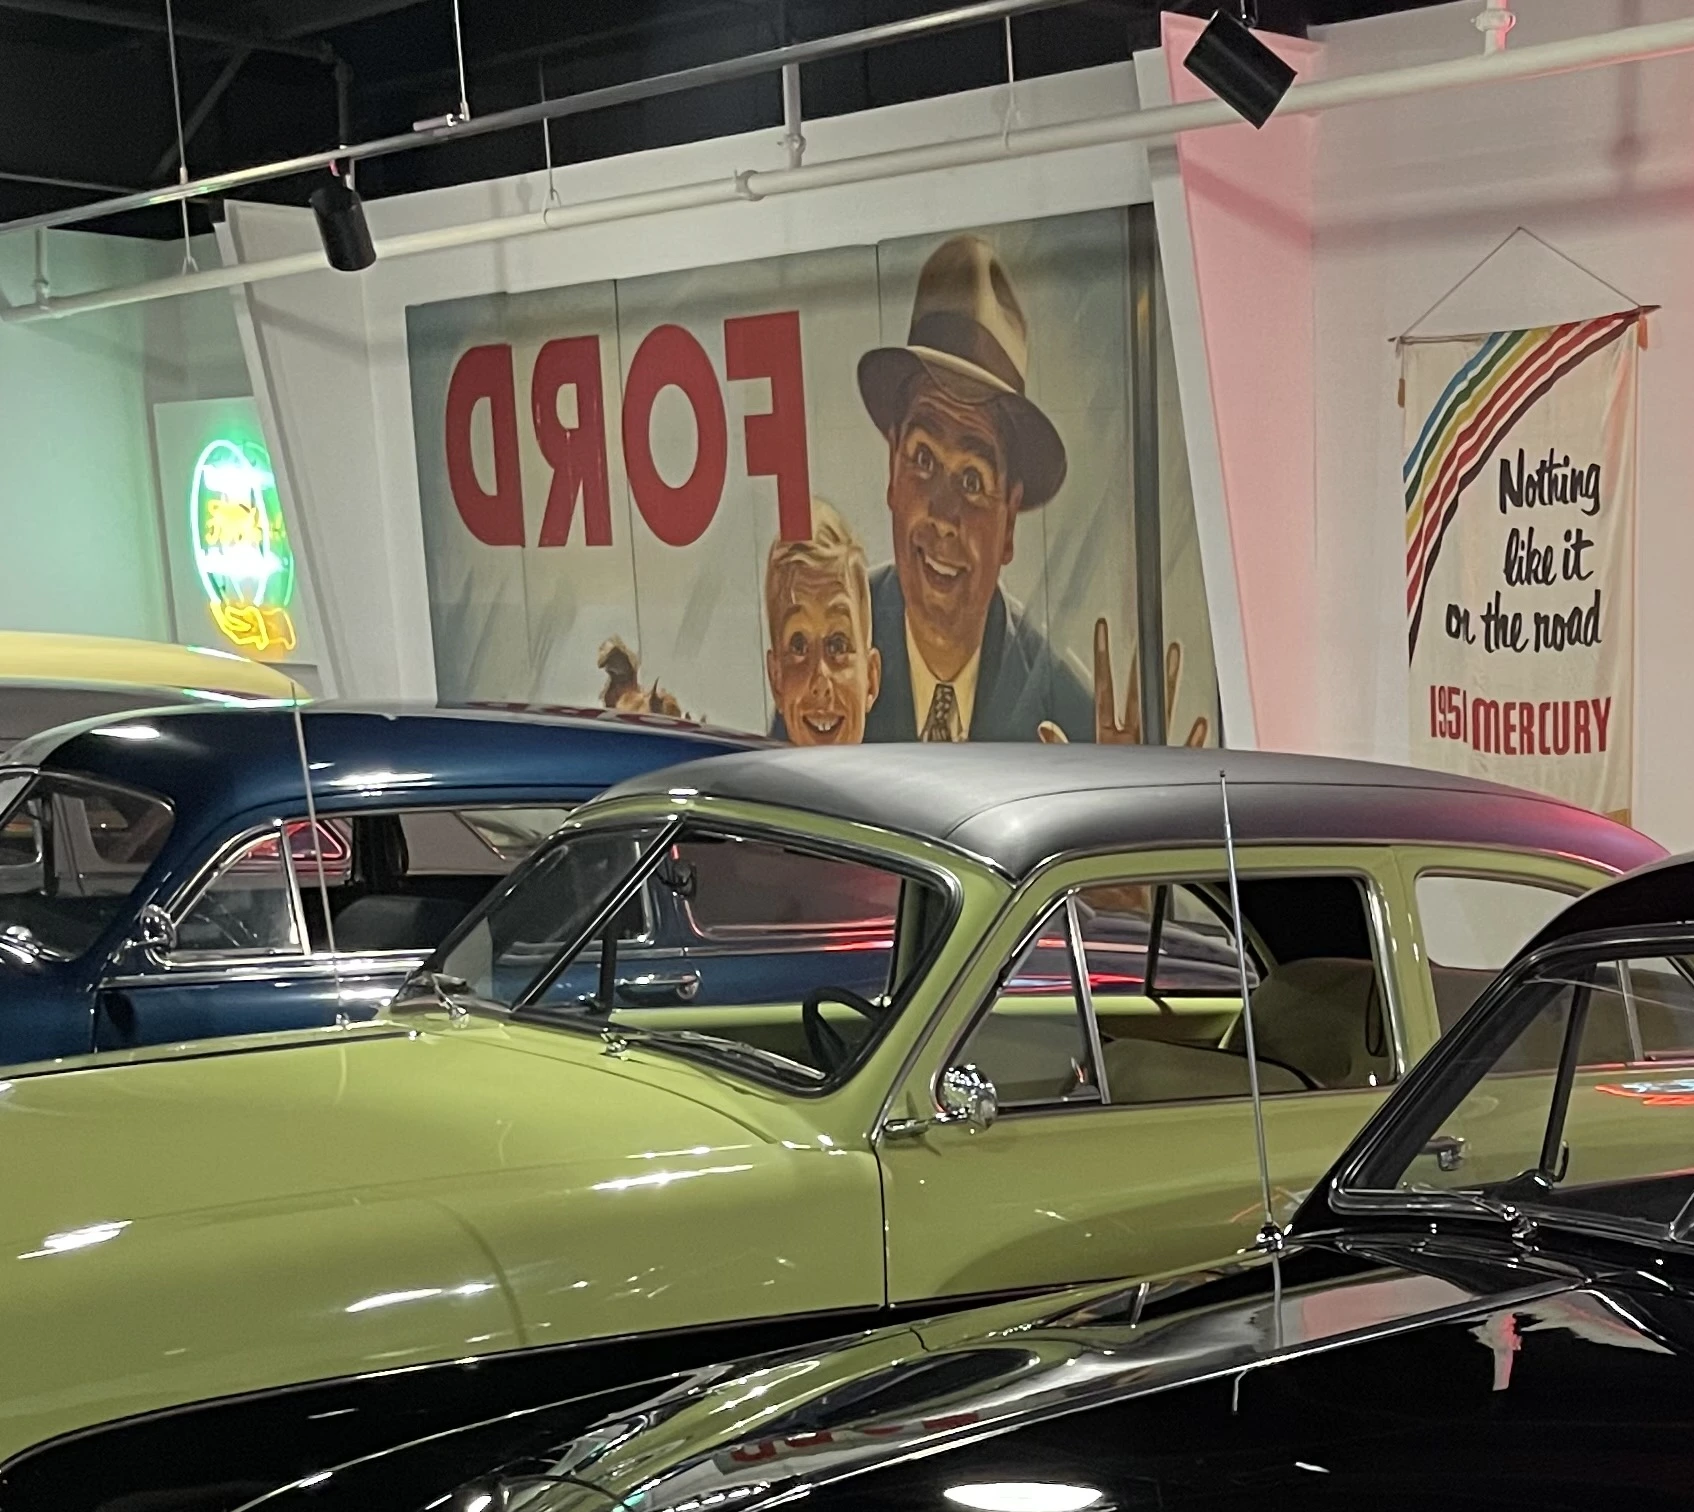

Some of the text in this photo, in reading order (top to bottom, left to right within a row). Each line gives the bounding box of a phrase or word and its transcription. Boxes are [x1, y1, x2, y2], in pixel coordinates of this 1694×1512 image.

[1500, 447, 1600, 516] Nothing
[1504, 526, 1595, 587] like it
[1480, 590, 1529, 653] the
[1533, 589, 1602, 654] road
[1430, 684, 1611, 756] 1951 MERCURY
